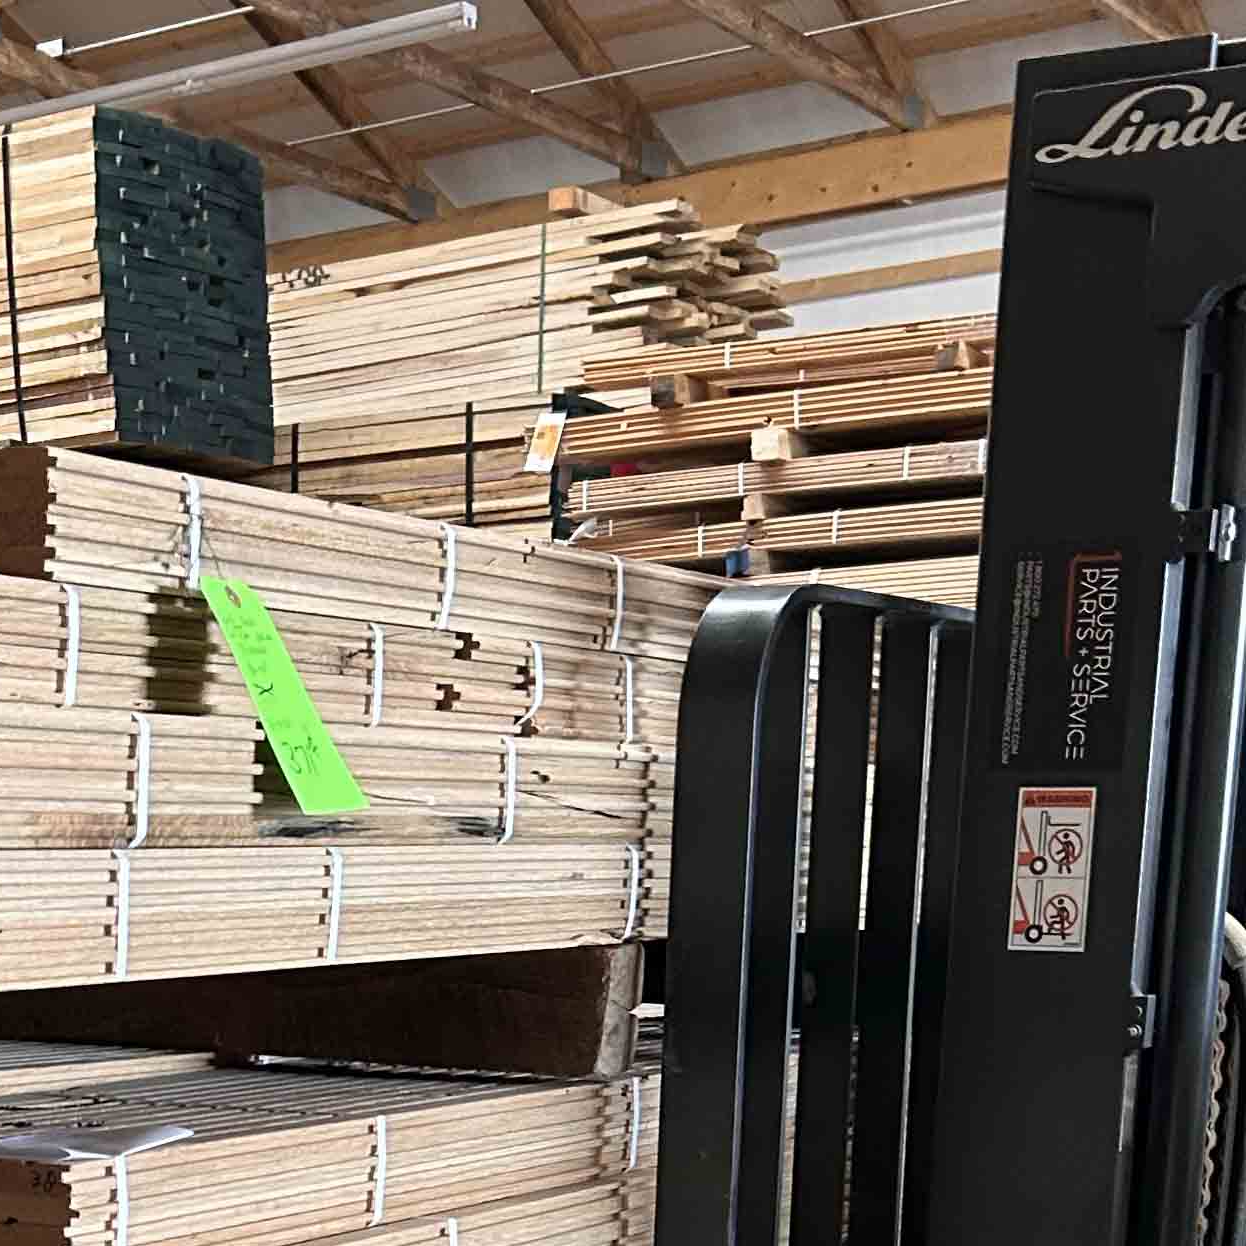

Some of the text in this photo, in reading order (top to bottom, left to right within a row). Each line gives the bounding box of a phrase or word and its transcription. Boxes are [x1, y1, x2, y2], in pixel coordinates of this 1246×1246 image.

[1035, 84, 1246, 163] Linde
[1064, 568, 1101, 760] PARTS + SERVICE
[1088, 567, 1121, 704] INDUSTRIAL
